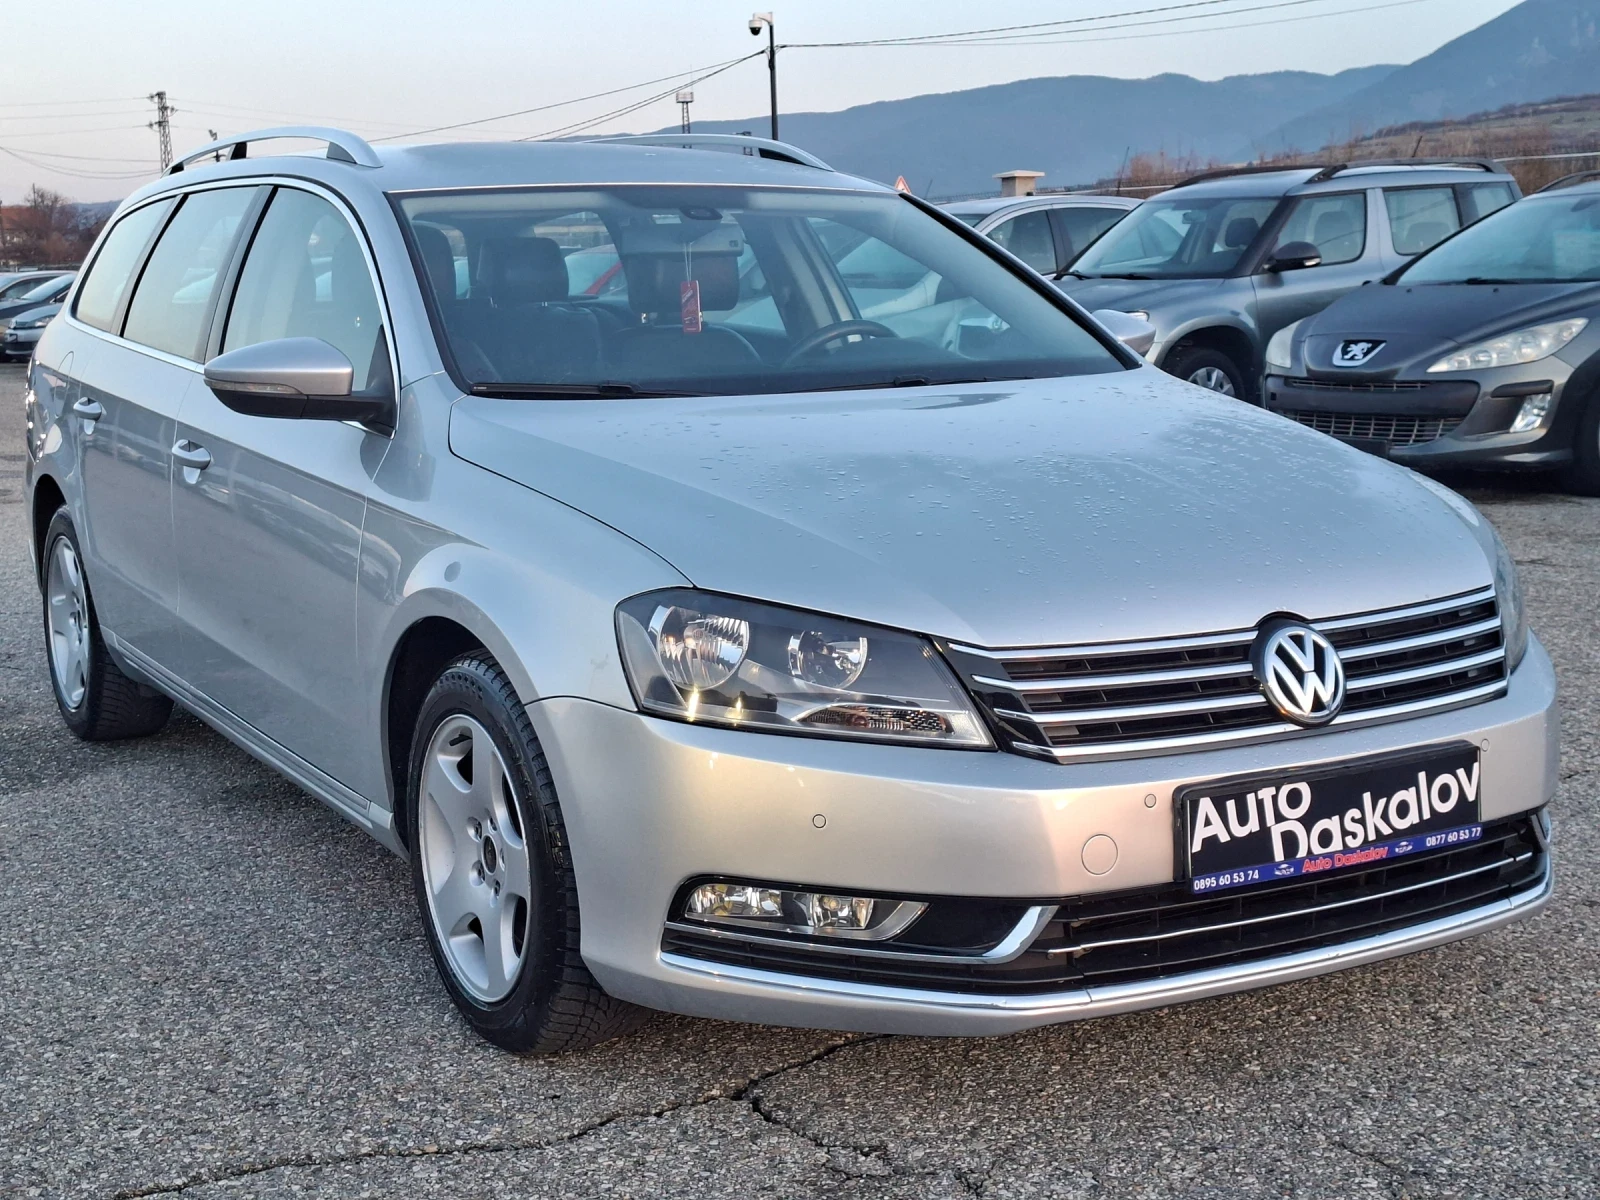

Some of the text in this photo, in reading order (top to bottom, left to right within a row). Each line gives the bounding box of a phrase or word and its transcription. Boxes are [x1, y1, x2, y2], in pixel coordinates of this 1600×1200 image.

[1271, 762, 1480, 862] Daskalov
[1426, 827, 1481, 847] 0877 60 53 77
[1302, 848, 1388, 873] Auto Daskalov
[1193, 869, 1260, 891] 0895 60 53 74
